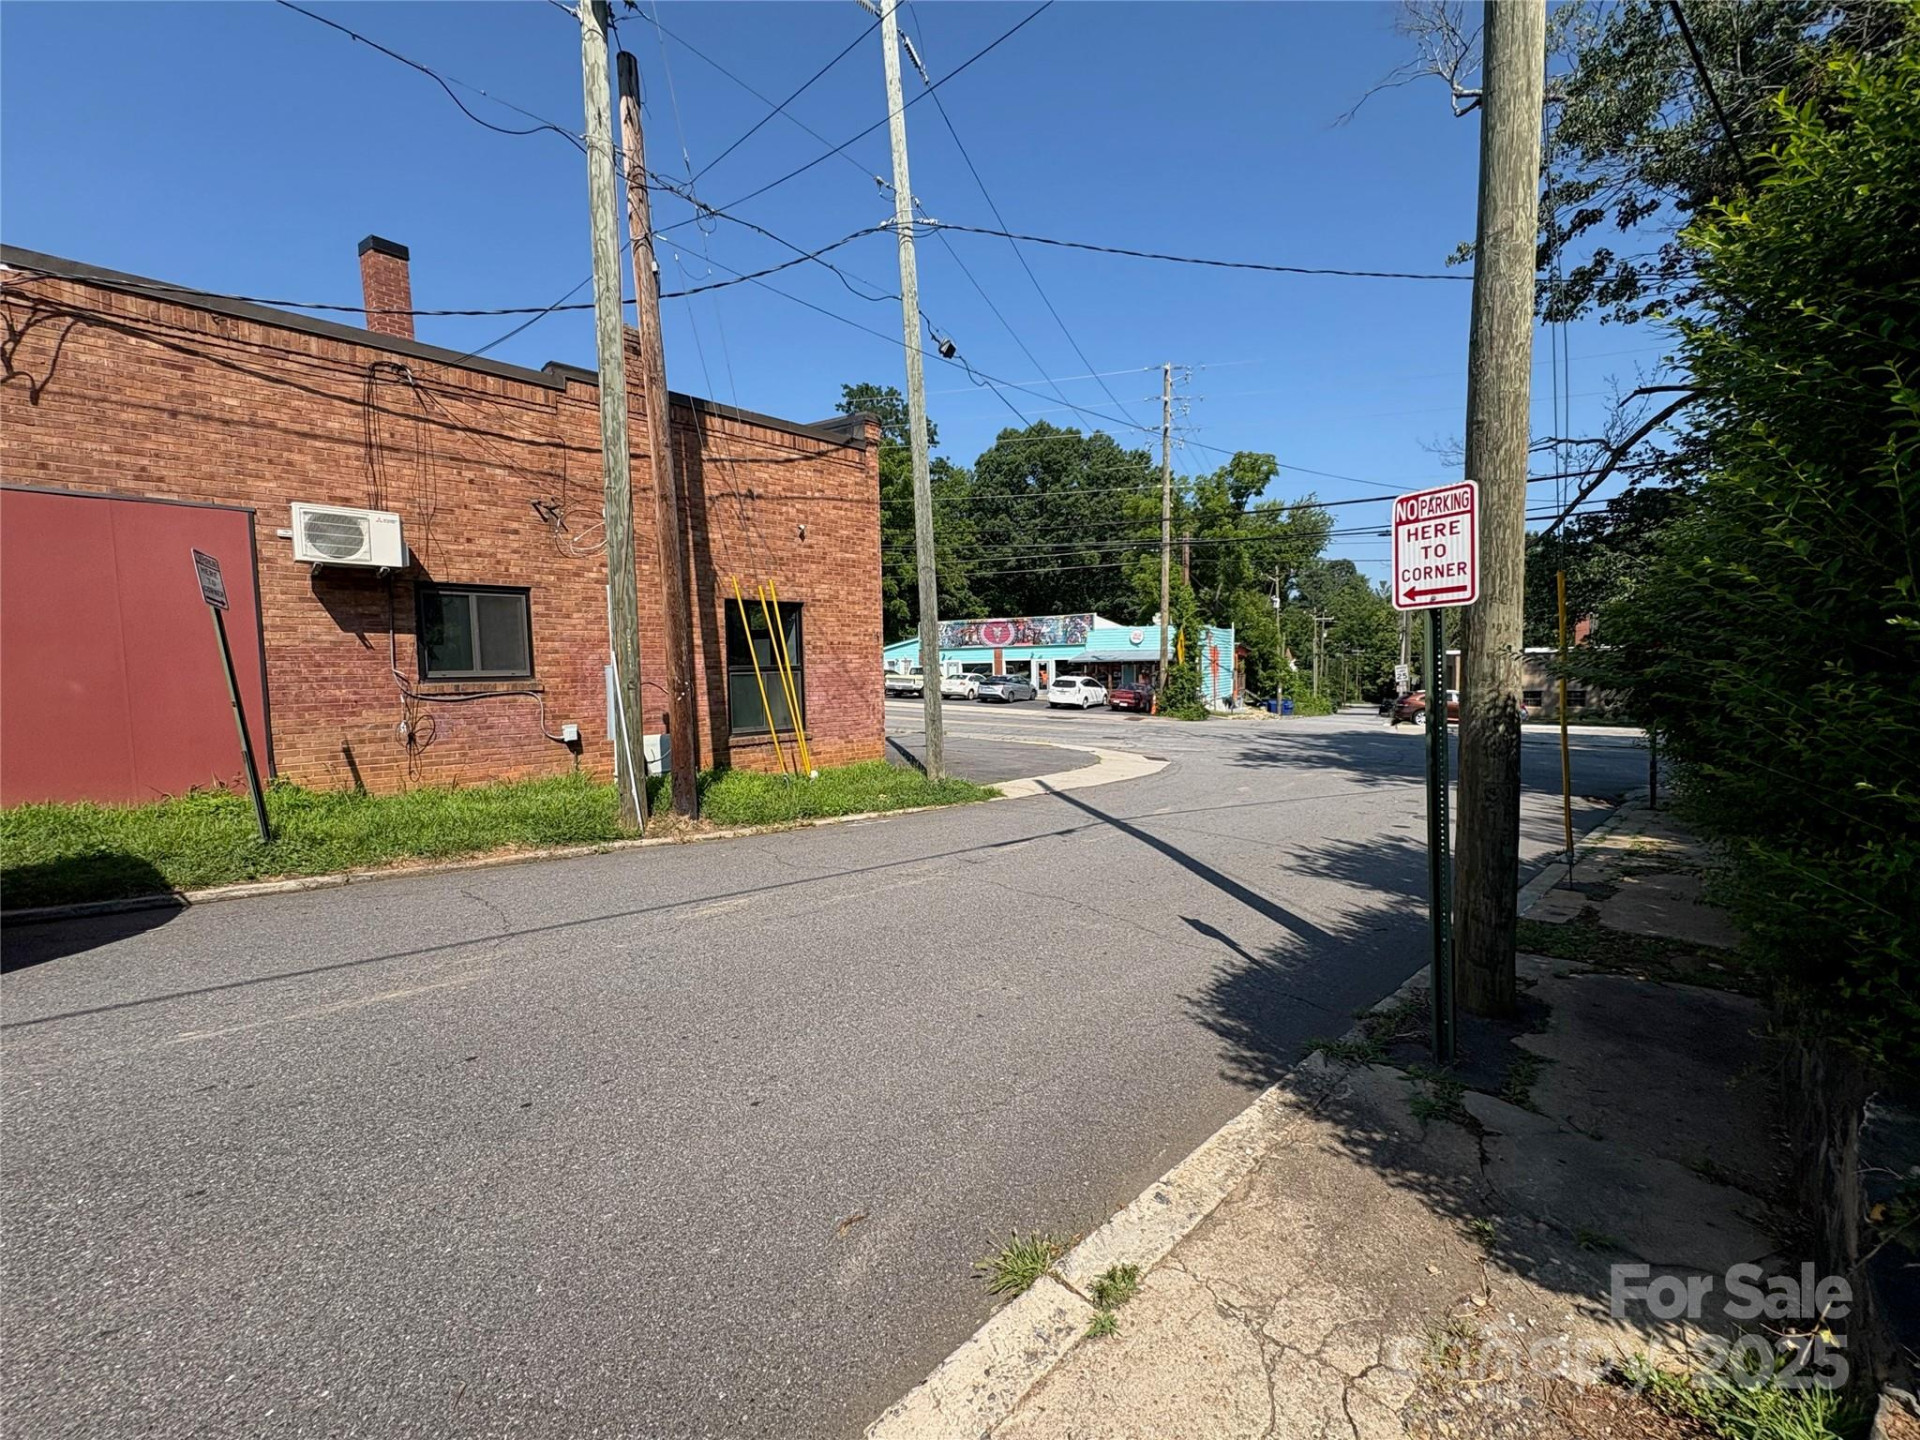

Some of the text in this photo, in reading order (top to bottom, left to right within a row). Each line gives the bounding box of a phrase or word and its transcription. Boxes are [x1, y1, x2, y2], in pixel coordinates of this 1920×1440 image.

[1396, 491, 1469, 522] NO PARKING
[1407, 520, 1460, 542] HERE
[1420, 544, 1446, 560] TO
[1402, 561, 1467, 582] CORNER
